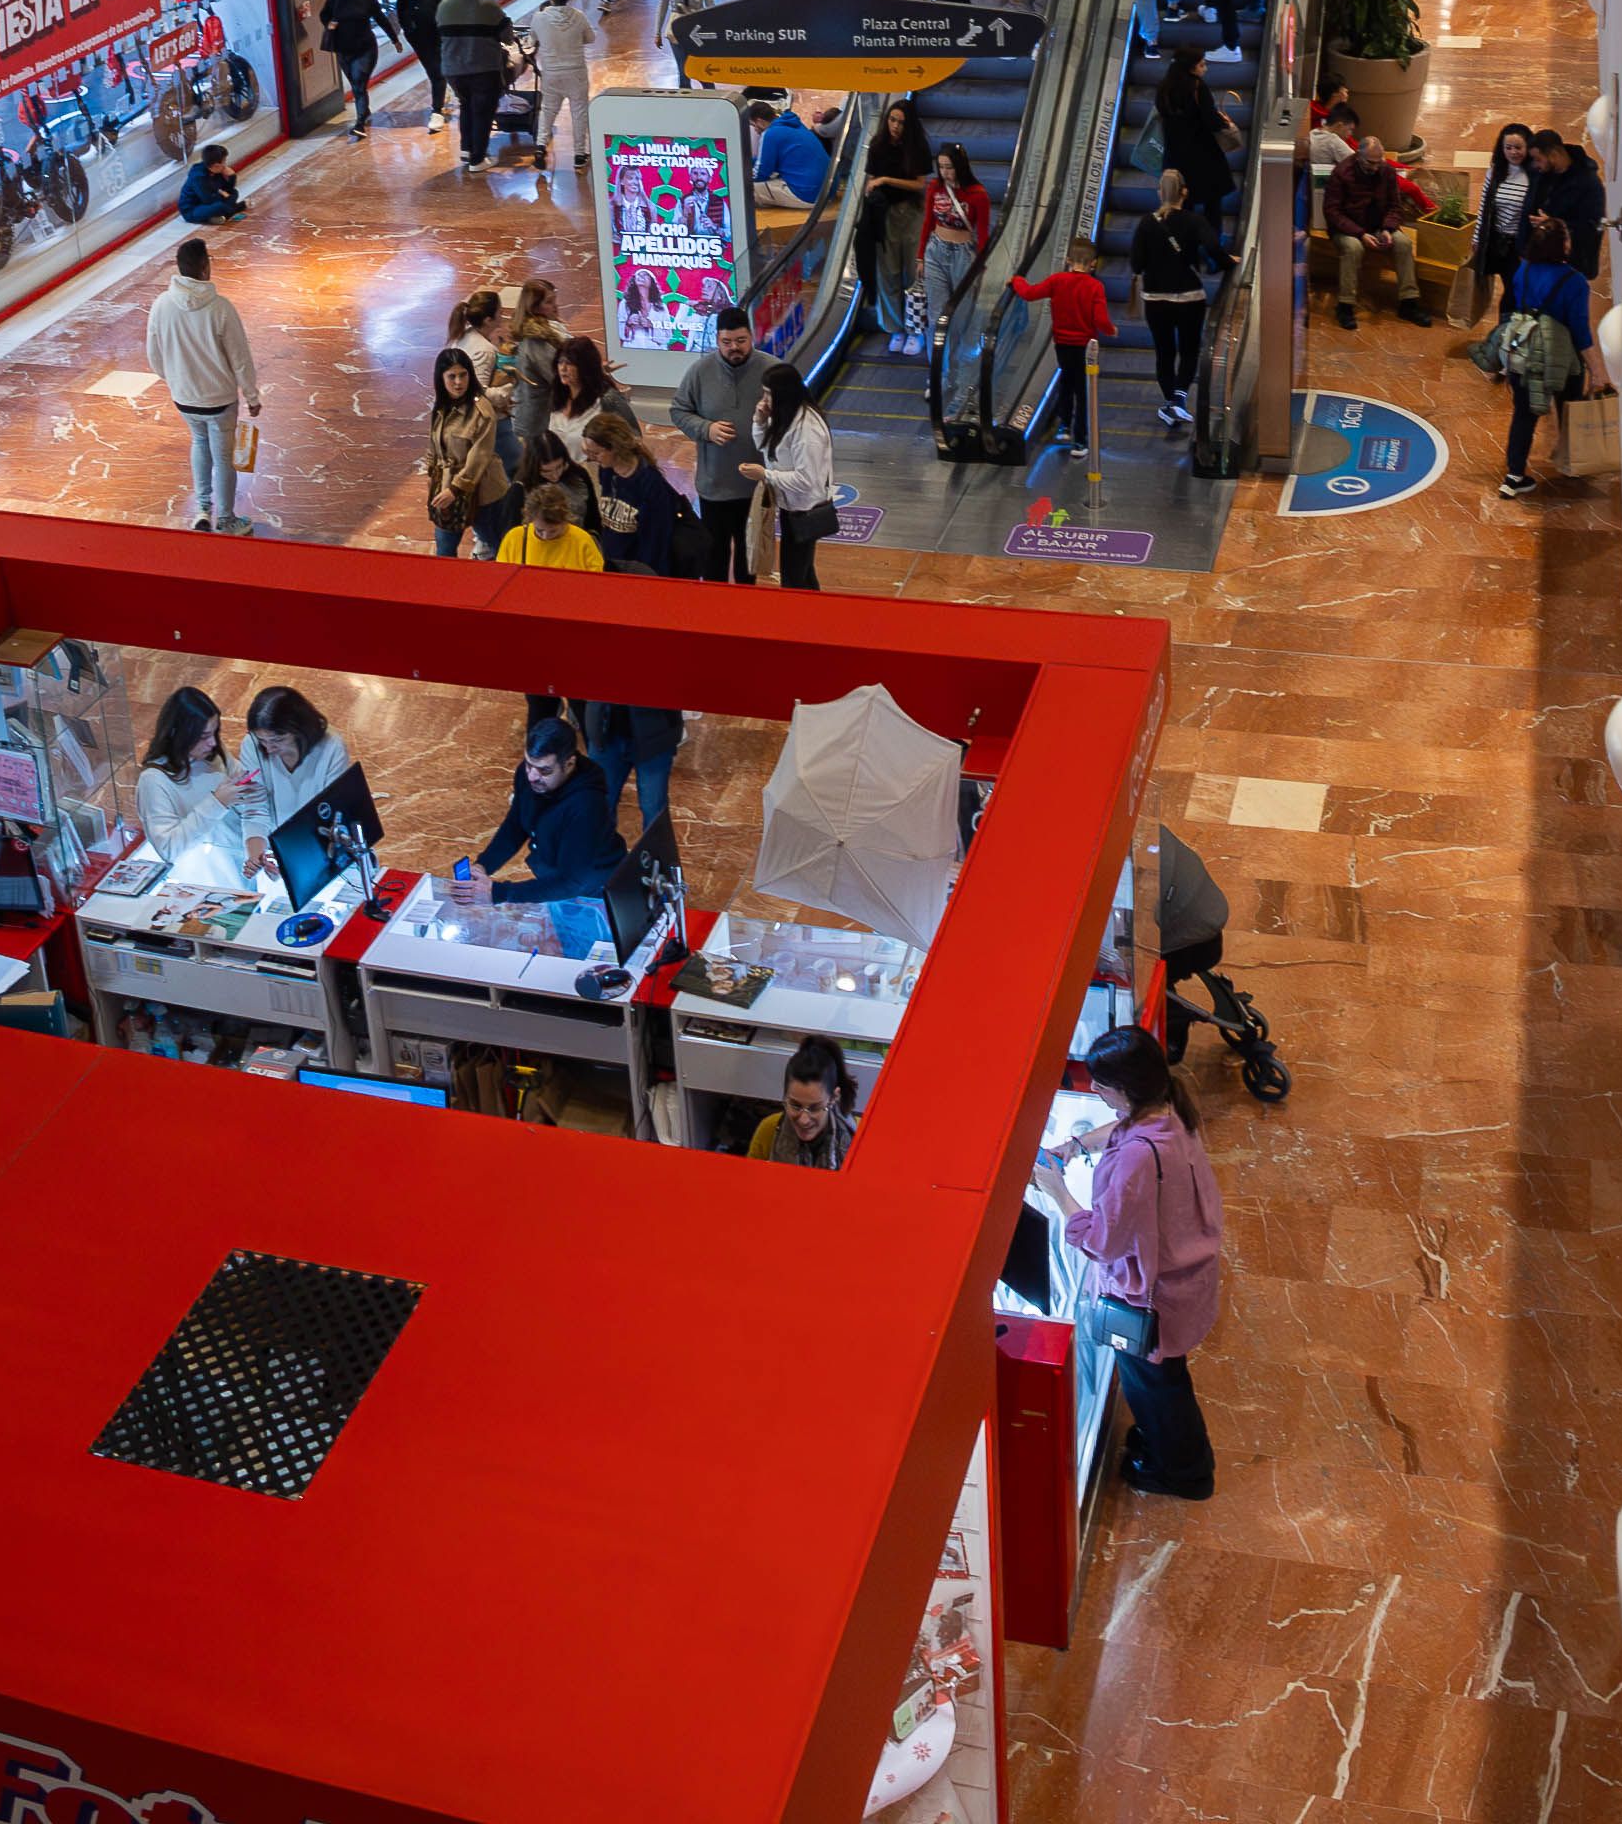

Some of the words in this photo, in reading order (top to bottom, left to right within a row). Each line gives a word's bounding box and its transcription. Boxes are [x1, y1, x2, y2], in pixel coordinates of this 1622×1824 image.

[862, 18, 897, 30] Plaza
[901, 18, 950, 30] Central
[725, 29, 775, 43] Parking
[778, 29, 807, 41] SUR
[853, 35, 895, 47] Planta
[899, 35, 951, 47] Primera
[153, 37, 178, 66] LET'S
[178, 28, 196, 55] GO!
[645, 141, 690, 156] MILLÓN
[612, 154, 629, 166] DE
[629, 155, 719, 169] ESPECTADORES
[1088, 161, 1103, 184] LOS
[1084, 185, 1098, 201] EN
[1079, 203, 1095, 229] PIES
[650, 222, 689, 237] OCHO
[621, 236, 723, 256] APELLIDOS
[632, 253, 713, 271] MARROQUÍS
[1339, 402, 1365, 429] TÁCTIL
[1023, 529, 1047, 538] AL
[1052, 530, 1109, 542] SUBIR
[1020, 537, 1033, 545] Y
[1037, 538, 1099, 550] BAJAR
